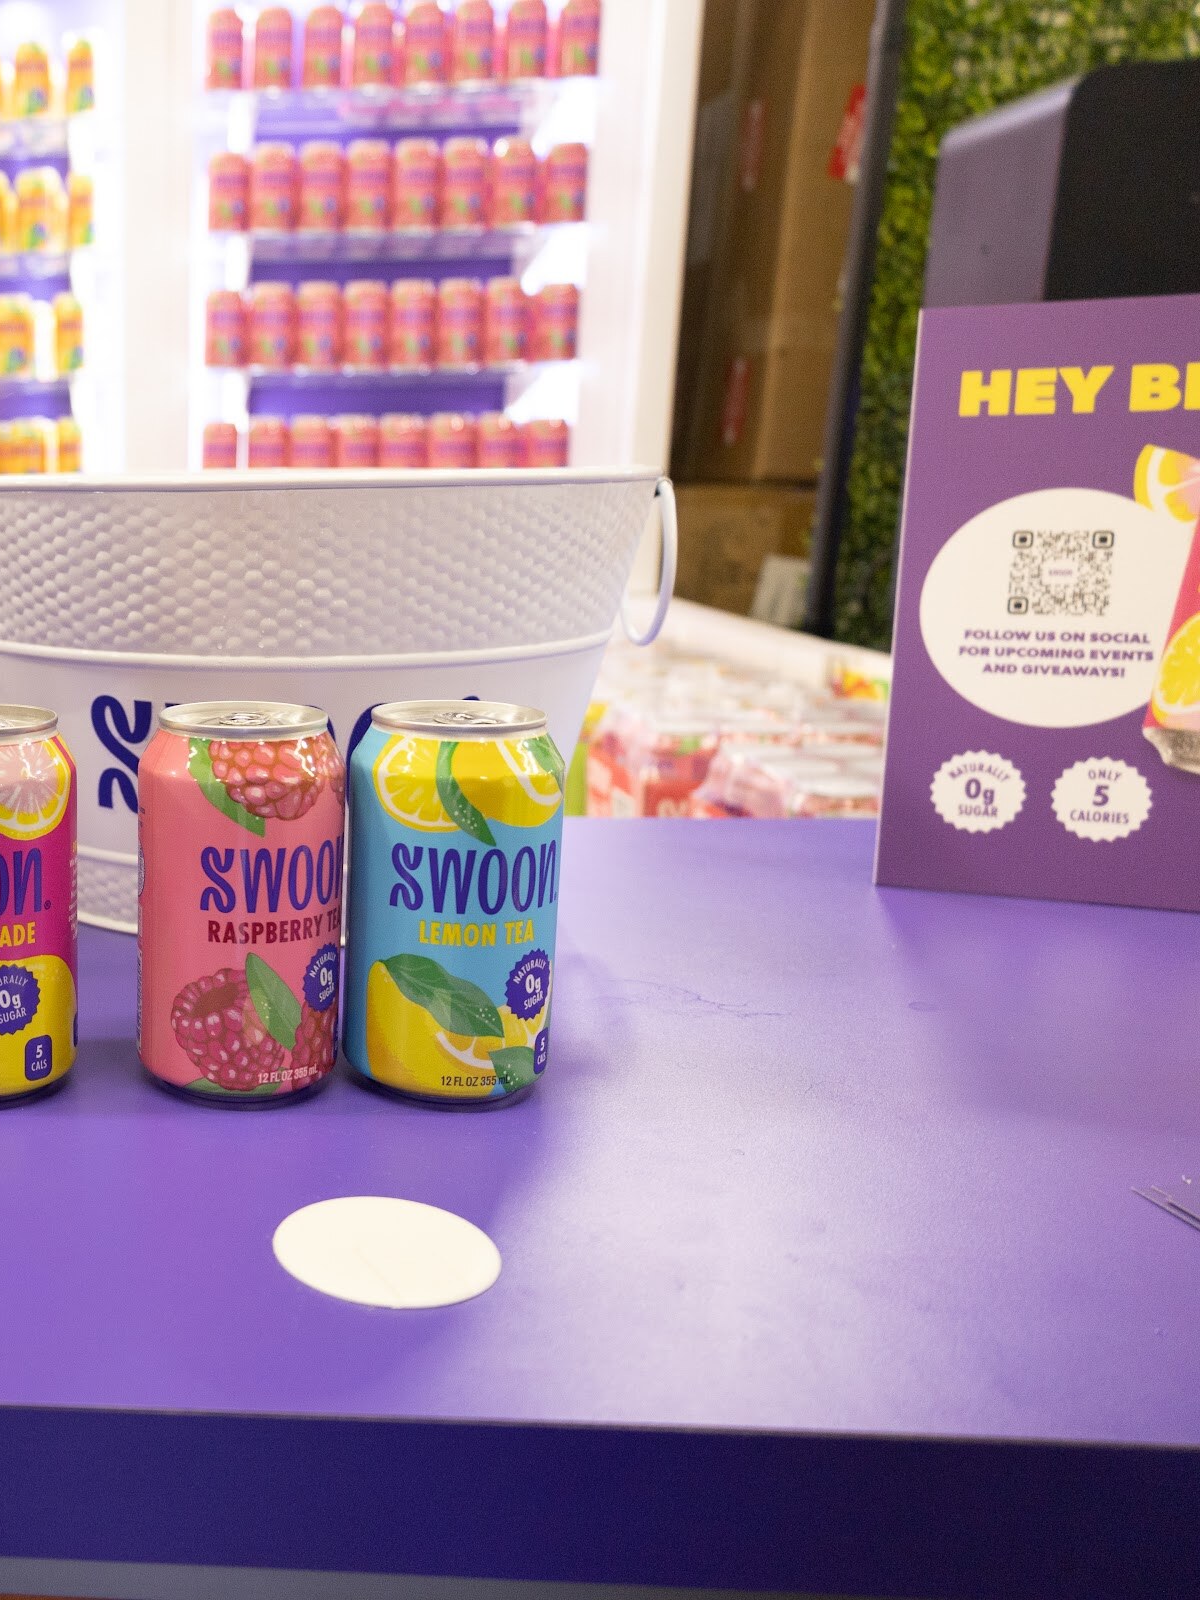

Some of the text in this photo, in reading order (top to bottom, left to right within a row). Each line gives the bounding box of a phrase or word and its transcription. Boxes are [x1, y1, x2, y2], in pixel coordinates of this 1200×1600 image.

[959, 365, 1114, 417] HEY
[964, 630, 1150, 644] FOLLOW US ON SOCIAL
[959, 646, 1154, 661] FOR UPCOMING EVENTS
[983, 663, 1125, 678] AND GIVEAWAYS!
[948, 763, 1011, 783] NATURALLY
[1088, 768, 1122, 782] ONLY
[965, 778, 995, 805] 0g
[1093, 785, 1109, 806] 5
[958, 804, 998, 818] SUGAR
[1070, 809, 1129, 825] CALORIES
[389, 839, 556, 915] SWOON
[208, 913, 323, 944] RASPBERRY
[419, 919, 535, 947] LEMON TEA
[309, 952, 337, 978] NATURALLY
[513, 958, 546, 984] NATURALLY
[320, 967, 332, 986] 0g
[525, 974, 541, 993] 0g
[0, 990, 21, 1010] 0g
[319, 982, 334, 1002] SUGAR
[524, 991, 543, 1010] SUGAR
[35, 1044, 43, 1058] 5
[540, 1037, 545, 1052] 5
[31, 1059, 47, 1072] CALS
[257, 1073, 266, 1084] 12
[267, 1071, 279, 1083] FL
[280, 1070, 293, 1082] OZ
[294, 1067, 308, 1080] 355
[441, 1075, 510, 1087] 12 FL OZ 355 mL
